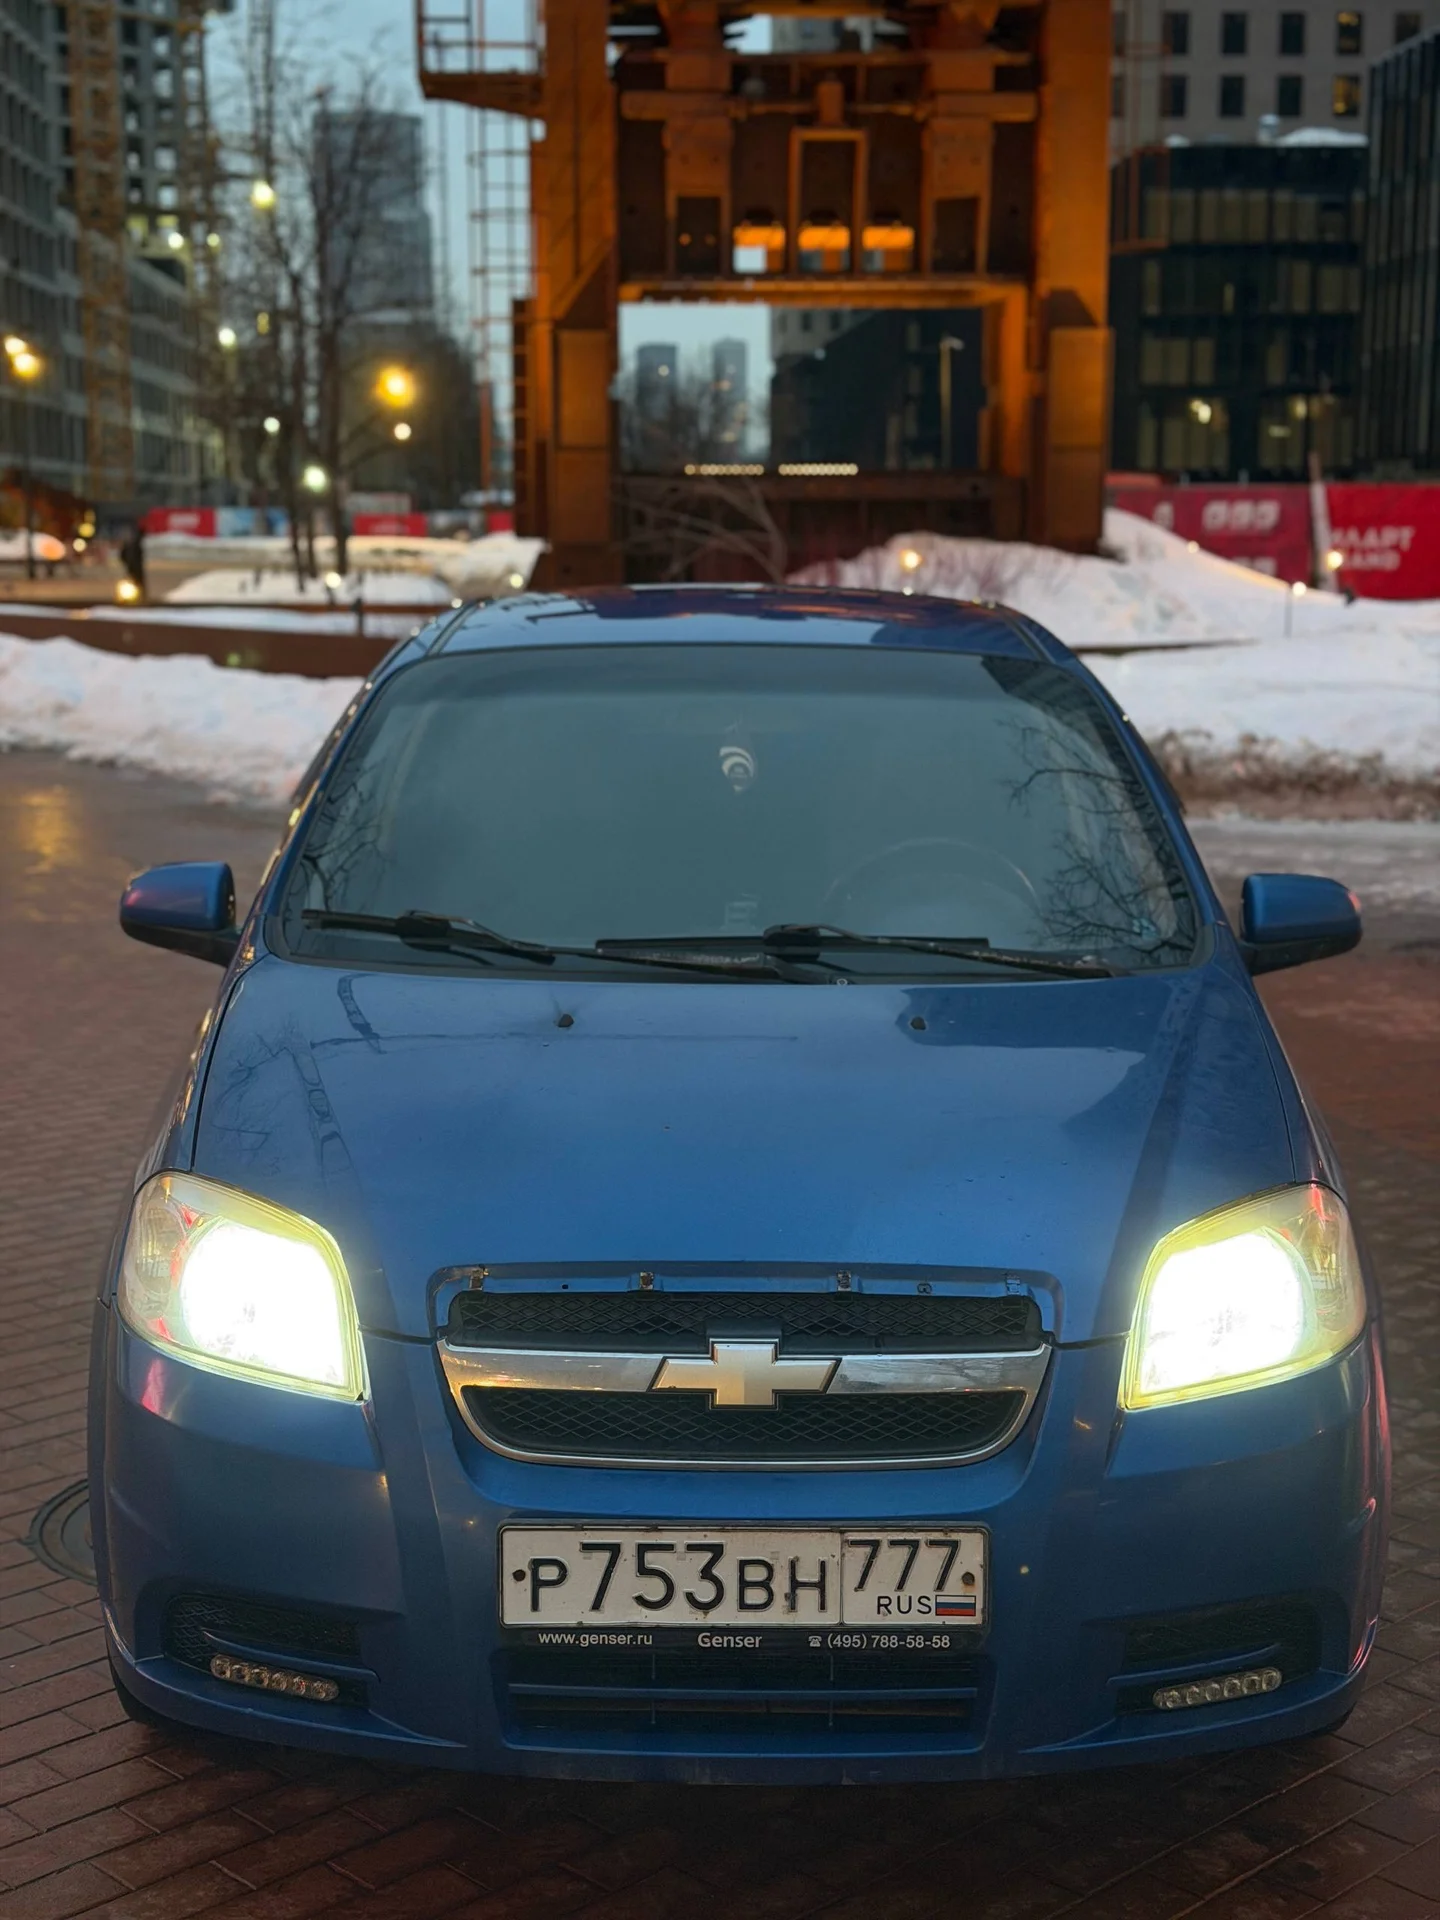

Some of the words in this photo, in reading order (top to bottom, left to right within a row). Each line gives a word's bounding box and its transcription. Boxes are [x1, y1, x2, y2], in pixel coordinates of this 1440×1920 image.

[847, 1538, 961, 1592] 777
[876, 1595, 933, 1616] RUS
[538, 1632, 653, 1648] www.genser.ru
[697, 1632, 762, 1649] Genser
[827, 1633, 868, 1650] (495)
[871, 1634, 951, 1649] 788-58-58
